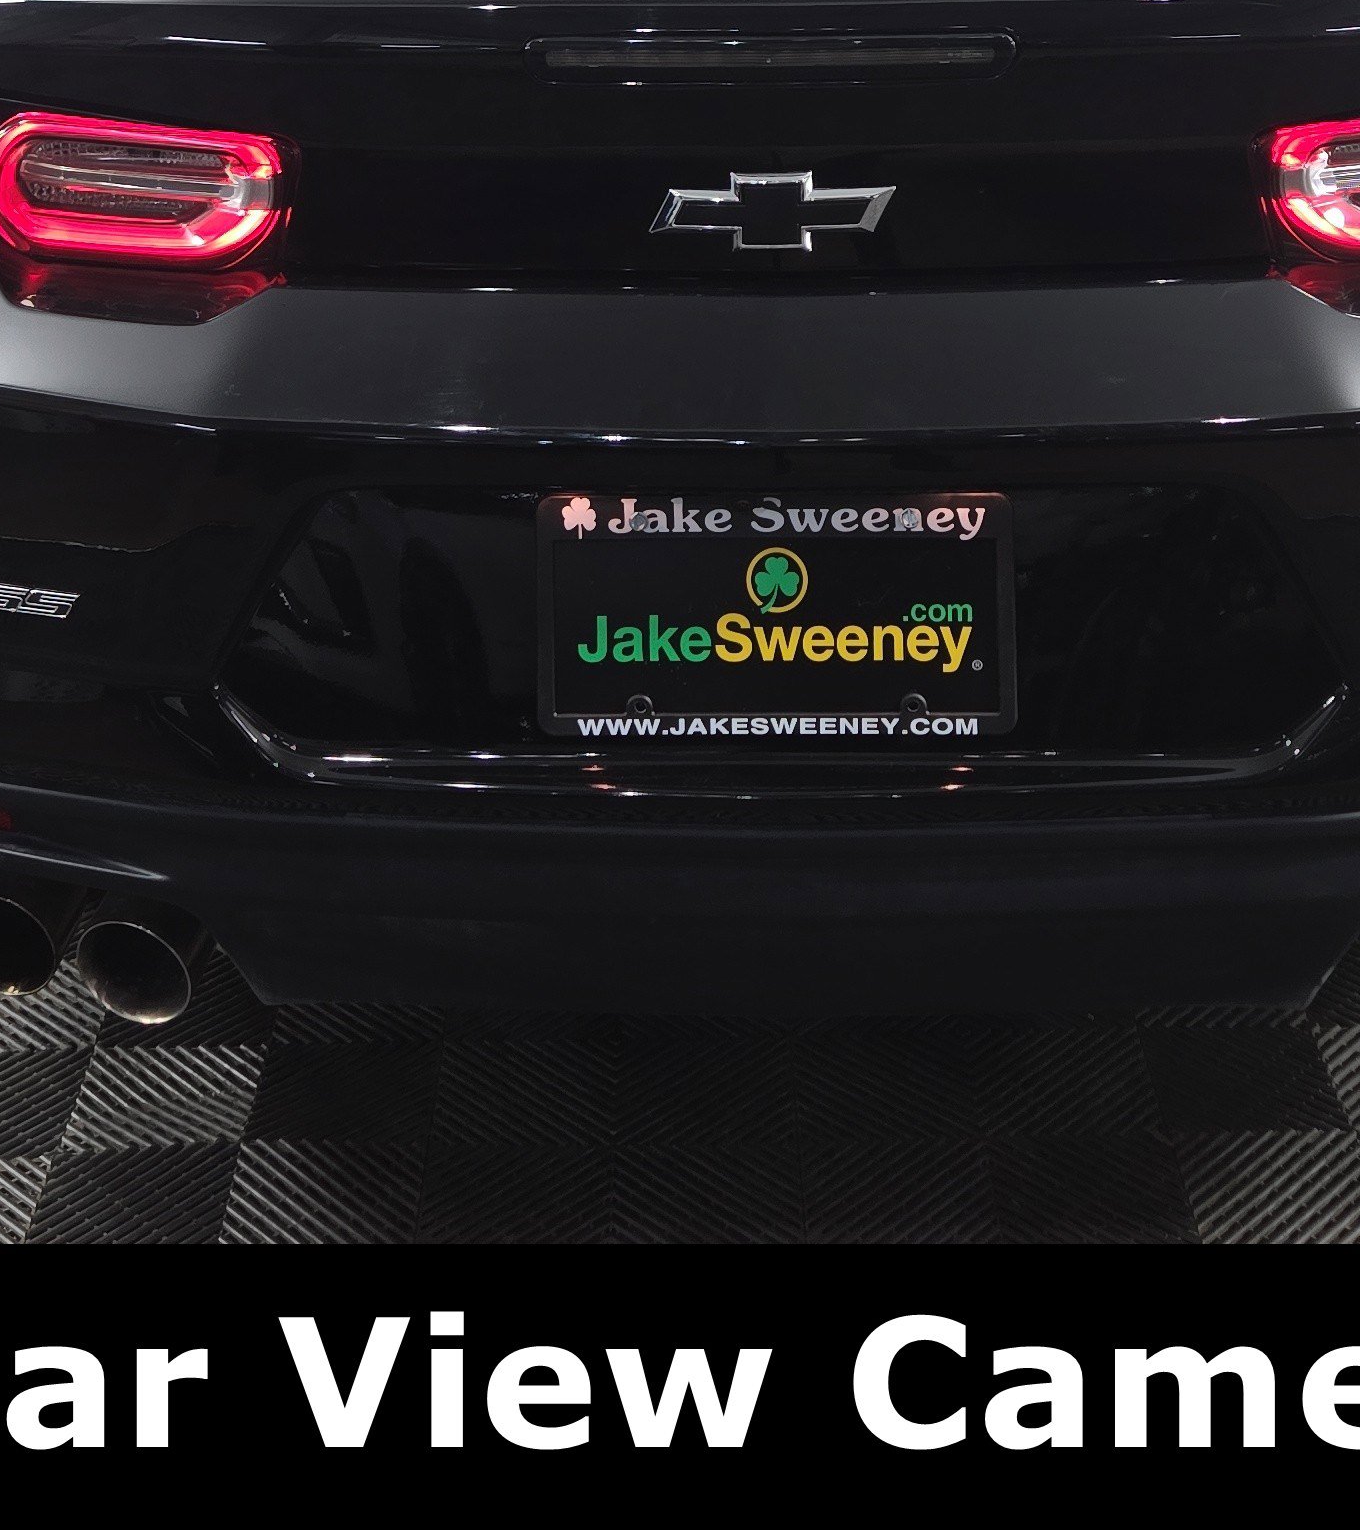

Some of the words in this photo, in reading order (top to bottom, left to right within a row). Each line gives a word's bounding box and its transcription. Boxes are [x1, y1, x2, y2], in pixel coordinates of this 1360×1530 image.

[607, 497, 733, 534] Jake
[750, 497, 986, 541] Sweeney
[577, 717, 979, 736] WWW.JAKESWEENEY.COM
